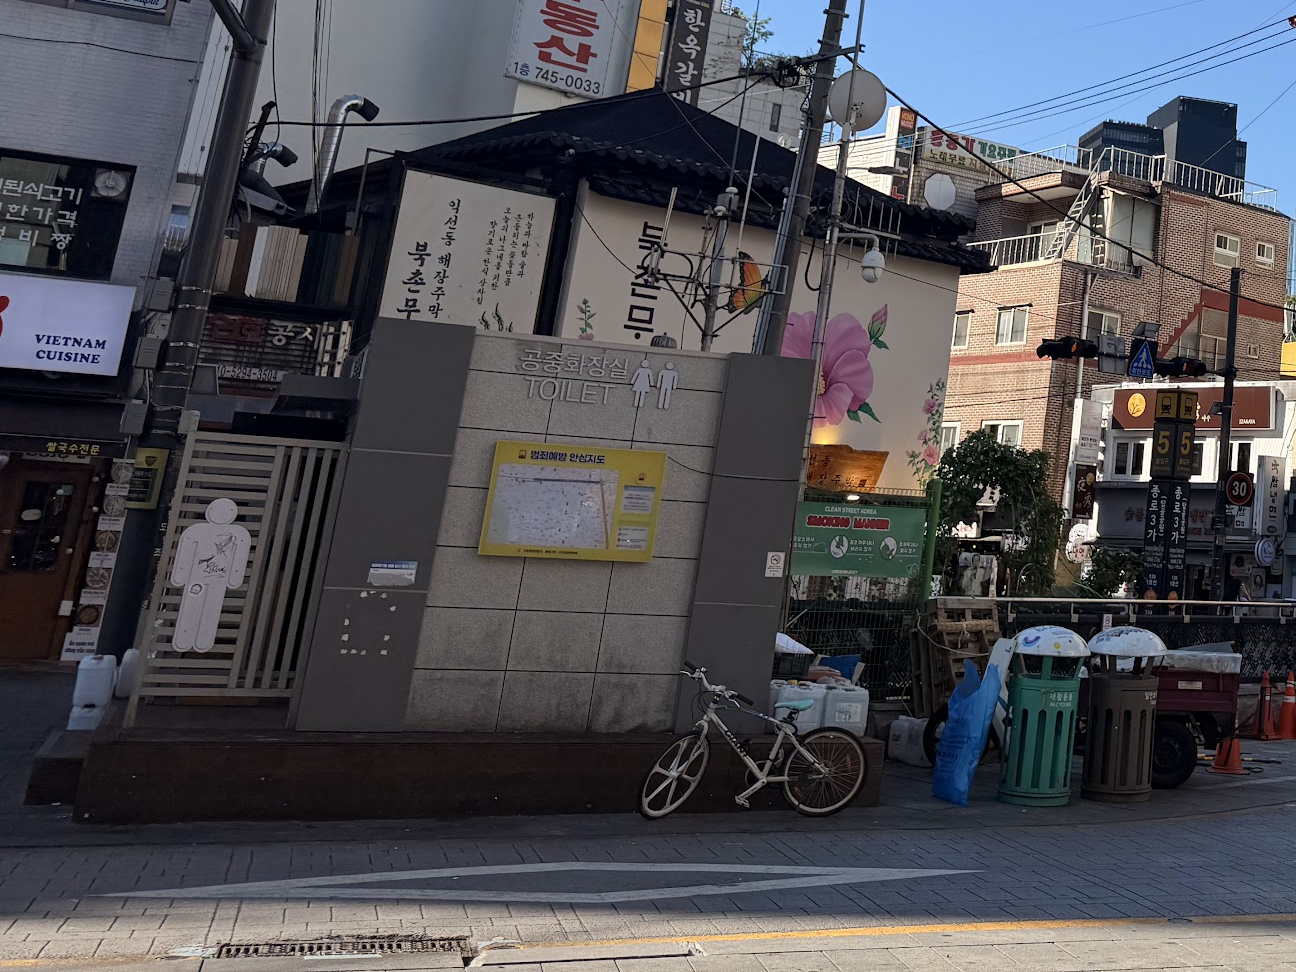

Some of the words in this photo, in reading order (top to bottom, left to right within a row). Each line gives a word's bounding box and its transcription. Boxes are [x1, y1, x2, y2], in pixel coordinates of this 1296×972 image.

[514, 61, 531, 77] 1층
[535, 66, 601, 94] 745-0033
[441, 198, 462, 247] 익선동
[396, 241, 432, 320] 북촌무
[428, 252, 452, 319] 해장주막
[35, 334, 107, 349] VIETNAM
[35, 349, 100, 364] CUISINE
[521, 349, 629, 379] 공중화장실
[216, 365, 278, 381] 10-5294-3504
[524, 377, 616, 405] TOILET
[46, 441, 100, 455] 쌀국수전문
[1157, 431, 1170, 455] 5
[1181, 431, 1191, 455] 5
[530, 450, 568, 462] 범죄예방
[569, 453, 605, 464] 안심지도
[1232, 481, 1247, 496] 30
[806, 514, 851, 528] SMOKING
[852, 517, 890, 531] MANNER
[1147, 485, 1160, 542] 종로3가
[1171, 486, 1182, 545] 종로3가
